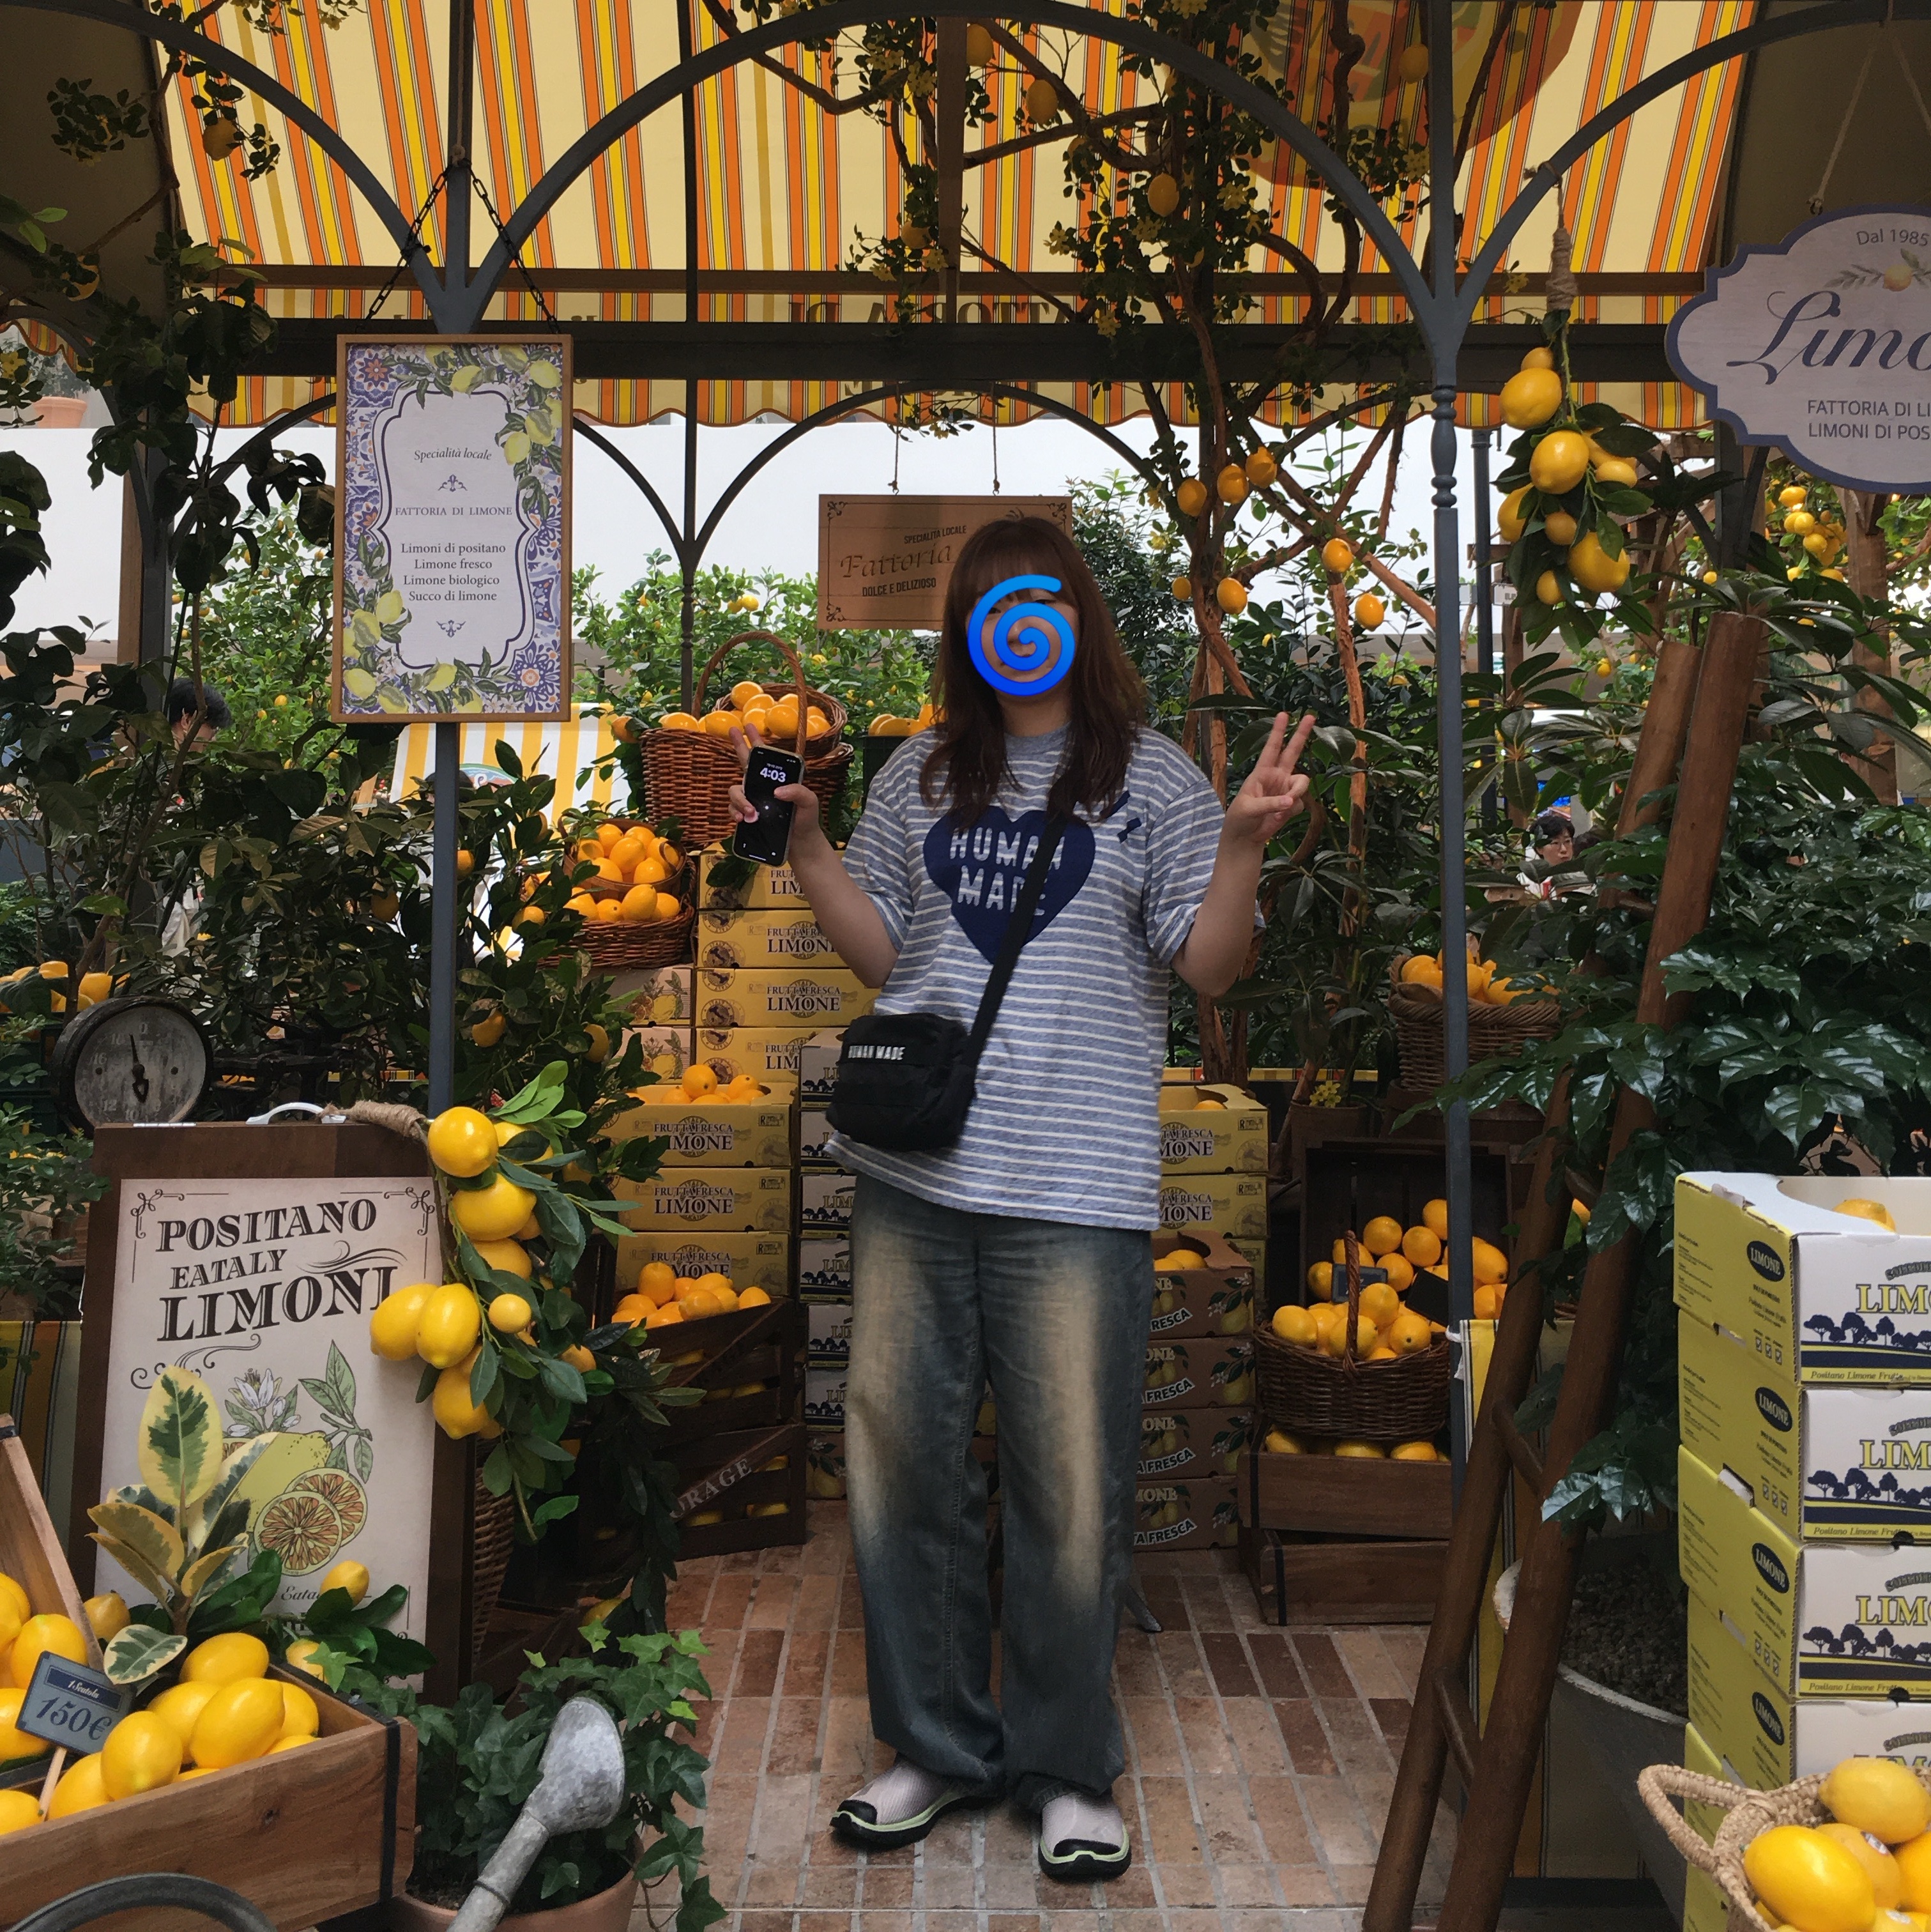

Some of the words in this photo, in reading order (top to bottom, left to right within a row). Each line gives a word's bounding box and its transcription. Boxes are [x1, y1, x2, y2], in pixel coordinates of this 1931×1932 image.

[1856, 229, 1884, 245] Dal
[1890, 229, 1930, 247] 1985
[1808, 400, 1889, 416] FATTORIA
[1895, 402, 1911, 417] DI
[1809, 423, 1868, 438] LIMONI
[1875, 424, 1891, 439] DI
[1898, 425, 1930, 440] POS
[414, 447, 461, 463] Specialità
[464, 448, 492, 460] locale
[395, 507, 447, 516] FATTORIA
[452, 507, 464, 516] DI
[469, 507, 512, 516] LIMONE
[942, 525, 966, 537] LOCALE
[401, 544, 441, 553] Limoni
[445, 543, 455, 553] di
[459, 543, 506, 556] positano
[414, 559, 457, 569] Limone
[460, 558, 492, 569] fresco
[841, 544, 951, 578] Fattoria
[403, 575, 446, 585] Limone
[449, 574, 500, 588] biologico
[862, 584, 887, 597] DOLCE
[890, 583, 894, 594] E
[896, 578, 936, 593] DELIZIOSO
[409, 591, 441, 601] Succo
[445, 590, 455, 601] di
[459, 590, 497, 601] limone
[759, 767, 786, 783] 4:03
[767, 997, 841, 1011] LIMONE
[654, 1123, 694, 1132] FRUTTA
[696, 1123, 733, 1132] FRESCA
[1177, 1128, 1213, 1138] FRESCA
[655, 1135, 733, 1150] IMONE
[655, 1186, 694, 1196] FRUTTA
[696, 1186, 733, 1196] FRESCA
[1176, 1193, 1212, 1203] FRESCA
[655, 1199, 733, 1214] LIMONE
[823, 1195, 853, 1208] LIM
[155, 1199, 377, 1252] POSITANO
[651, 1252, 691, 1261] FRUTTA
[692, 1252, 730, 1261] FRESCA
[1750, 1247, 1782, 1275] LIMONE
[169, 1248, 287, 1290] EATALY
[156, 1266, 398, 1342] LIMONI
[1856, 1284, 1931, 1314] LIM
[1150, 1309, 1190, 1330] RESCA
[1811, 1371, 1845, 1379] Positano
[1147, 1379, 1193, 1402] FRESCA
[1759, 1393, 1789, 1426] LIMONE
[1147, 1449, 1193, 1473] FRESCA
[1148, 1520, 1194, 1544] FRESCA
[1756, 1548, 1786, 1588] LIMONE
[1855, 1595, 1931, 1626] LIM
[36, 1696, 112, 1740] 150€
